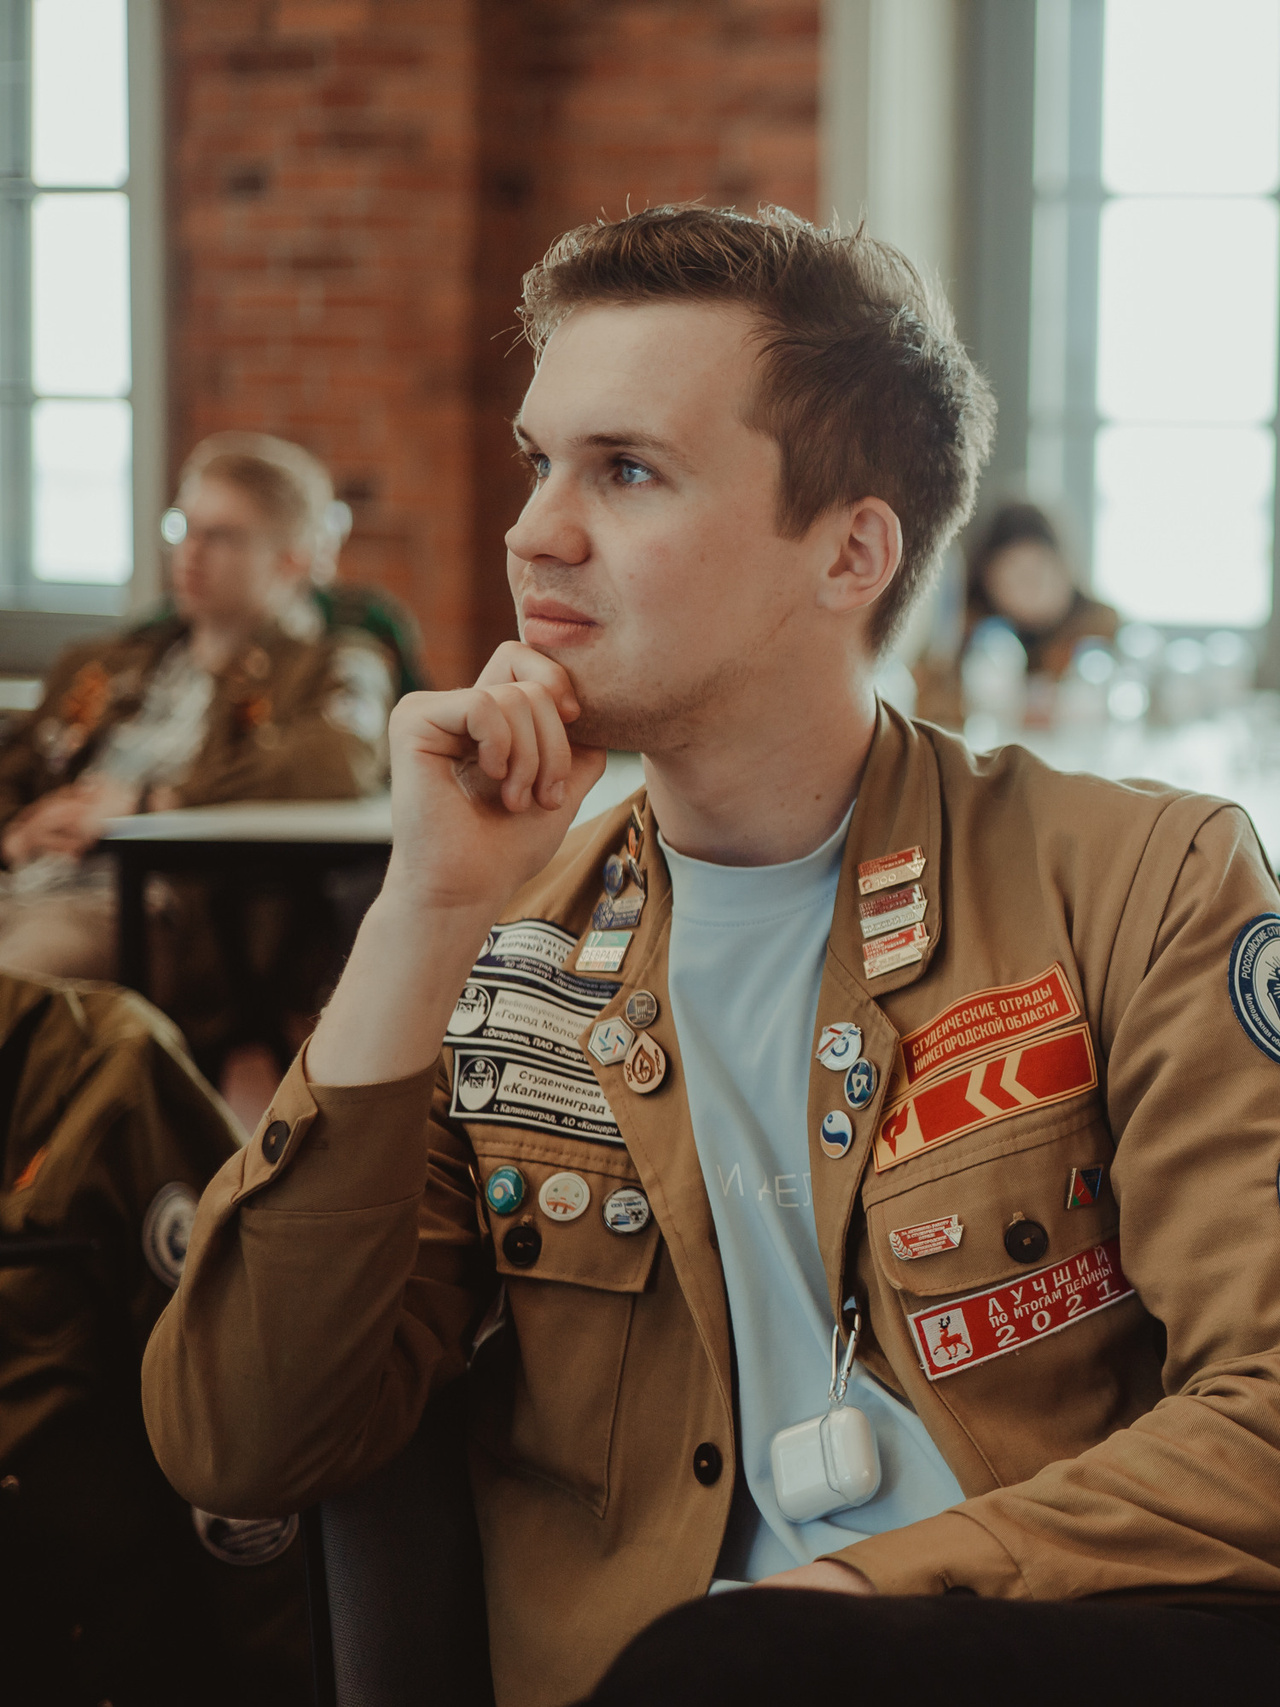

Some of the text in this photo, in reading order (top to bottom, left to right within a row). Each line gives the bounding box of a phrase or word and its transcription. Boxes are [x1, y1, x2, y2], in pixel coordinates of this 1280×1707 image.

[876, 873, 896, 887] 100
[546, 950, 564, 964] АТО
[581, 950, 624, 962] ФЕВРАЛЯ
[1241, 928, 1269, 980] РОССИЙСКИЕ
[495, 1008, 580, 1041] «Город Молод
[912, 984, 1053, 1057] СТУДЕНЧЕСКИЕ ОТРЯДЫ
[914, 999, 1059, 1074] НИЖЕГОРОДСКОЙ ОБЛАСТИ
[532, 1039, 554, 1051] ПАО
[554, 1045, 588, 1062] «Энерг
[503, 1082, 606, 1115] «Калининград
[519, 1070, 602, 1099] Студенческая
[500, 1104, 557, 1124] Калининград,
[561, 1116, 576, 1128] АО
[577, 1120, 619, 1135] «Концерн
[988, 1246, 1109, 1316] ЛУЧШИЙ
[989, 1264, 1113, 1328] ПО ИТОГАМ ЦЕЛИНЫ
[995, 1279, 1120, 1348] 2021
